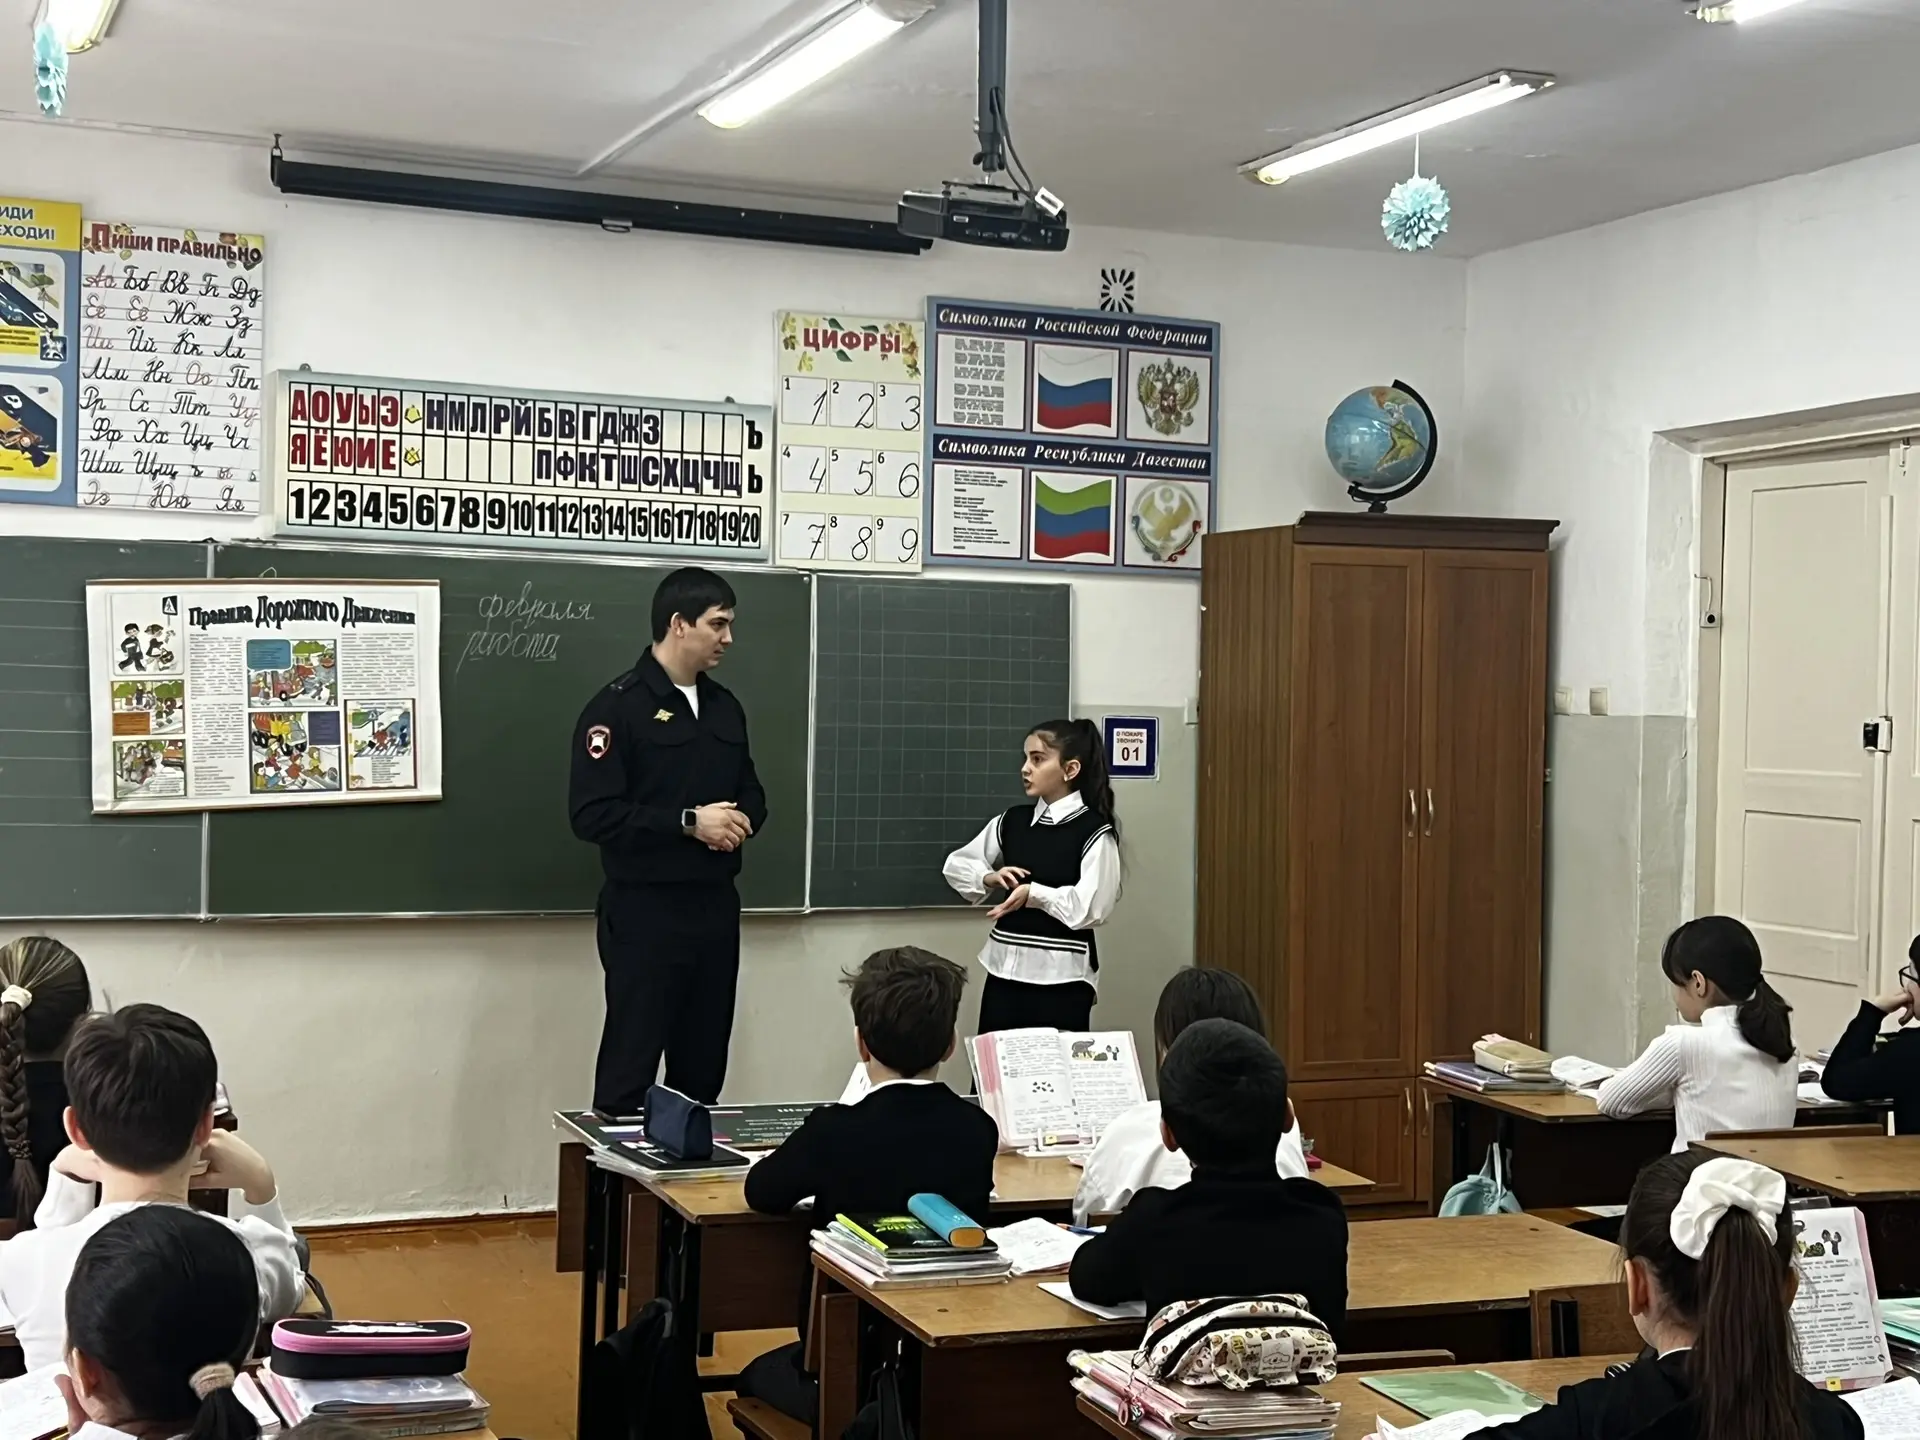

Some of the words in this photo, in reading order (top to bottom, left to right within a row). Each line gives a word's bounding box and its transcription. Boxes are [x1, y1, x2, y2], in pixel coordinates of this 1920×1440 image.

[157, 237, 262, 263] ПРАВИЛЬНО
[804, 328, 900, 354] ЦИФРЫ
[939, 308, 1027, 329] Символика
[1035, 316, 1120, 337] Российской
[1127, 326, 1208, 346] Федерации
[785, 379, 790, 390] 1
[832, 382, 839, 394] 2
[880, 385, 886, 396] 3
[292, 390, 307, 421] А
[312, 391, 330, 422] О
[336, 392, 354, 423] У
[358, 394, 376, 425] Ы
[381, 396, 398, 426] Э
[426, 400, 444, 430] Н
[449, 401, 465, 432] М
[470, 402, 486, 433] Л
[494, 404, 510, 434] Р
[514, 400, 531, 436] Й
[538, 407, 552, 438] Б
[559, 409, 575, 438] В
[582, 410, 596, 440] Г
[600, 412, 618, 444] Д
[622, 413, 639, 443] Ж
[642, 415, 659, 444] З
[746, 420, 762, 449] Ъ
[812, 390, 827, 425] 1
[855, 393, 874, 428] 2
[901, 396, 920, 430] 3
[291, 434, 306, 464] Я
[314, 428, 327, 466] Ё
[334, 436, 353, 467] Ю
[357, 438, 375, 468] И
[382, 440, 396, 470] Е
[537, 449, 552, 479] П
[556, 451, 574, 480] Ф
[579, 452, 596, 482] К
[601, 454, 617, 481] Т
[621, 455, 638, 484] Ш
[642, 456, 660, 486] С
[663, 458, 679, 487] Х
[683, 459, 699, 493] Ц
[704, 460, 720, 490] Ч
[724, 462, 742, 496] Щ
[748, 464, 762, 493] Ь
[782, 446, 790, 458] 4
[832, 450, 838, 461] 5
[878, 452, 884, 464] 6
[938, 438, 1026, 458] Символика
[1034, 444, 1126, 464] Республики
[1132, 451, 1207, 470] Дагестан
[810, 458, 826, 493] 4
[854, 460, 873, 495] 5
[899, 463, 918, 498] 6
[290, 488, 304, 518] 1
[312, 488, 330, 520] 2
[338, 490, 356, 522] 3
[364, 492, 382, 522] 4
[390, 494, 408, 524] 5
[416, 494, 434, 526] 6
[440, 496, 456, 526] 7
[462, 497, 480, 528] 8
[488, 499, 506, 529] 9
[511, 500, 531, 530] 10
[535, 502, 556, 532] 11
[560, 503, 579, 533] 12
[582, 504, 602, 534] 13
[606, 506, 625, 536] 14
[629, 506, 648, 536] 15
[652, 508, 670, 538] 16
[675, 510, 694, 538] 17
[698, 510, 717, 540] 18
[720, 512, 738, 542] 19
[742, 513, 758, 542] 20
[783, 514, 790, 526] 7
[830, 516, 838, 528] 8
[876, 519, 883, 530] 9
[808, 524, 825, 559] 7
[852, 527, 872, 560] 8
[898, 528, 918, 562] 9
[189, 605, 253, 630] Правила
[256, 595, 339, 630] Дорожного
[342, 596, 416, 628] Движения
[479, 580, 595, 631] февраля
[455, 619, 561, 676] работа
[1122, 746, 1139, 761] 01
